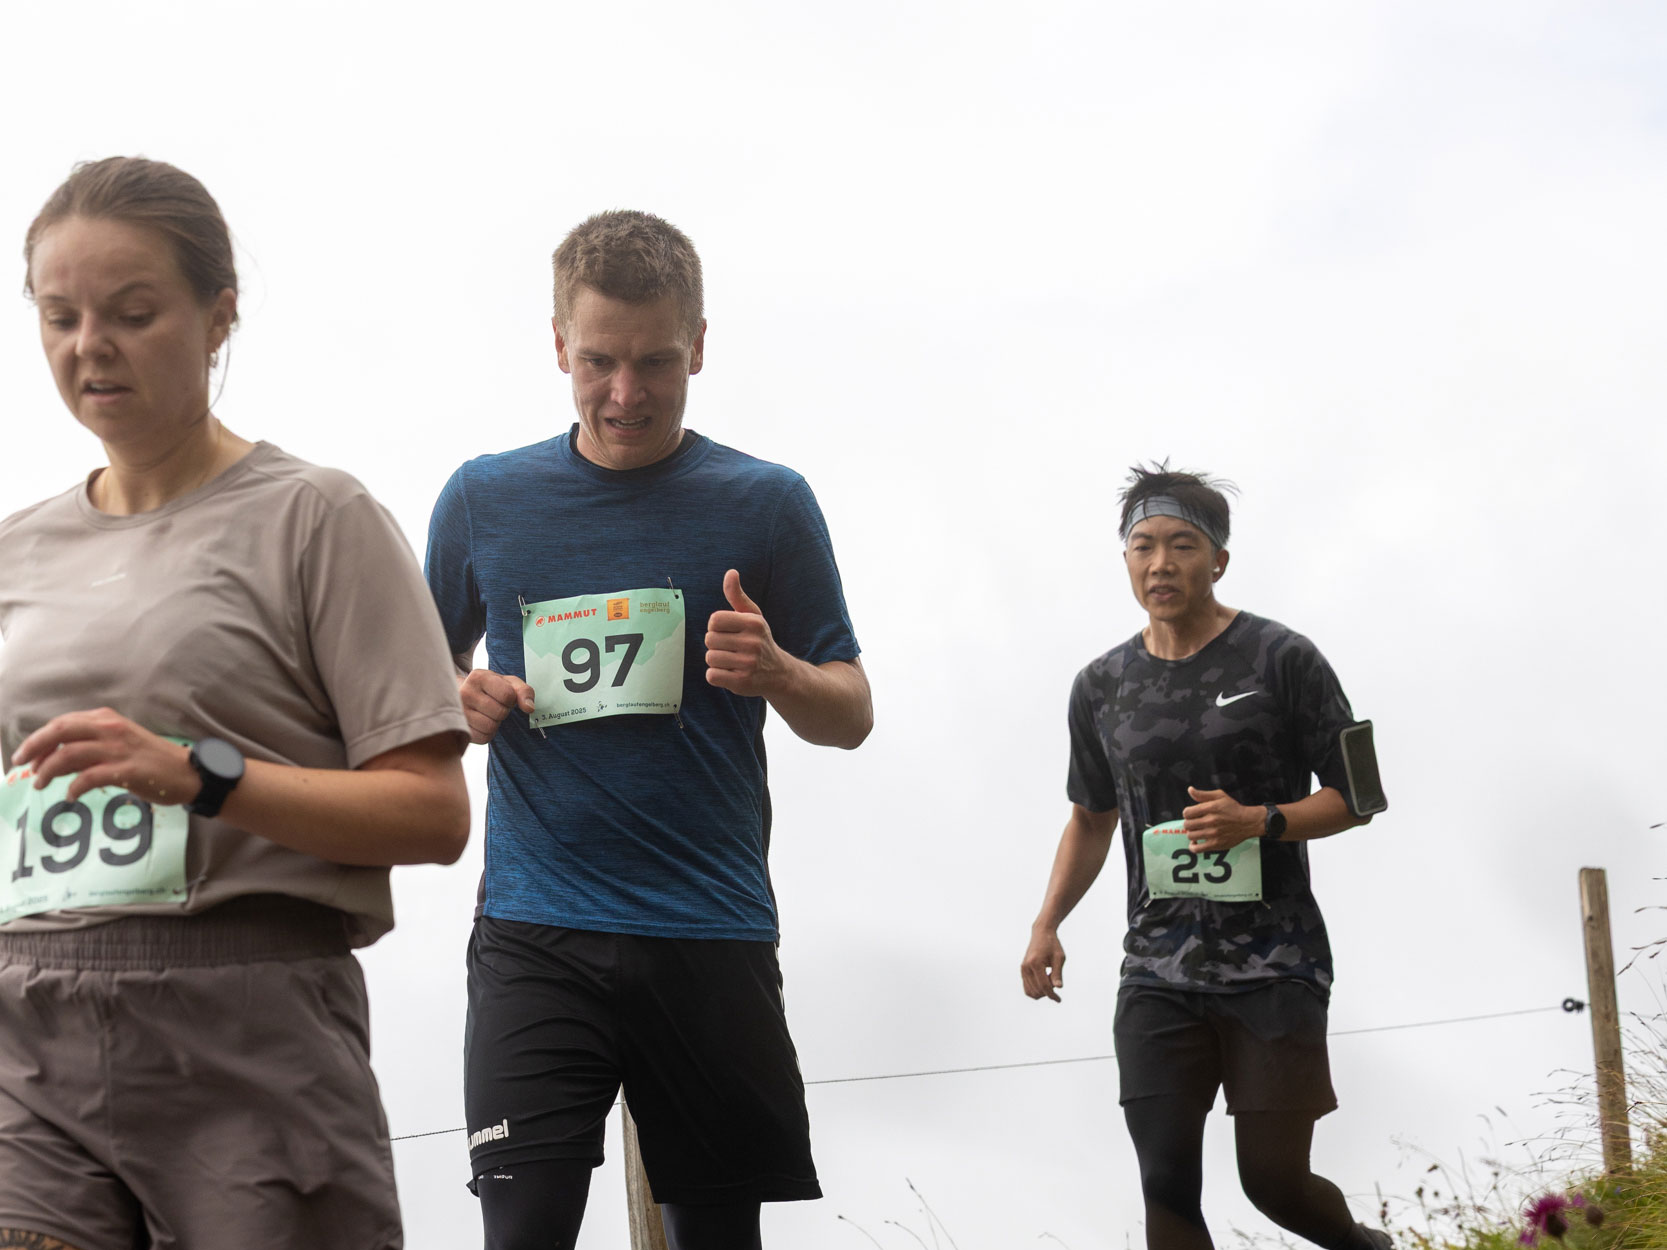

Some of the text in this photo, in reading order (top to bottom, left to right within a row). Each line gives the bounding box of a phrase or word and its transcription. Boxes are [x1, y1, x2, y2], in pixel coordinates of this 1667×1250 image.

[547, 608, 598, 624] MAMMUT
[639, 601, 671, 609] berglauf
[561, 632, 645, 694] 97
[548, 709, 570, 720] August
[570, 706, 587, 716] 2025
[11, 792, 155, 884] 199
[1171, 848, 1232, 884] 23
[468, 1118, 510, 1151] ummel
